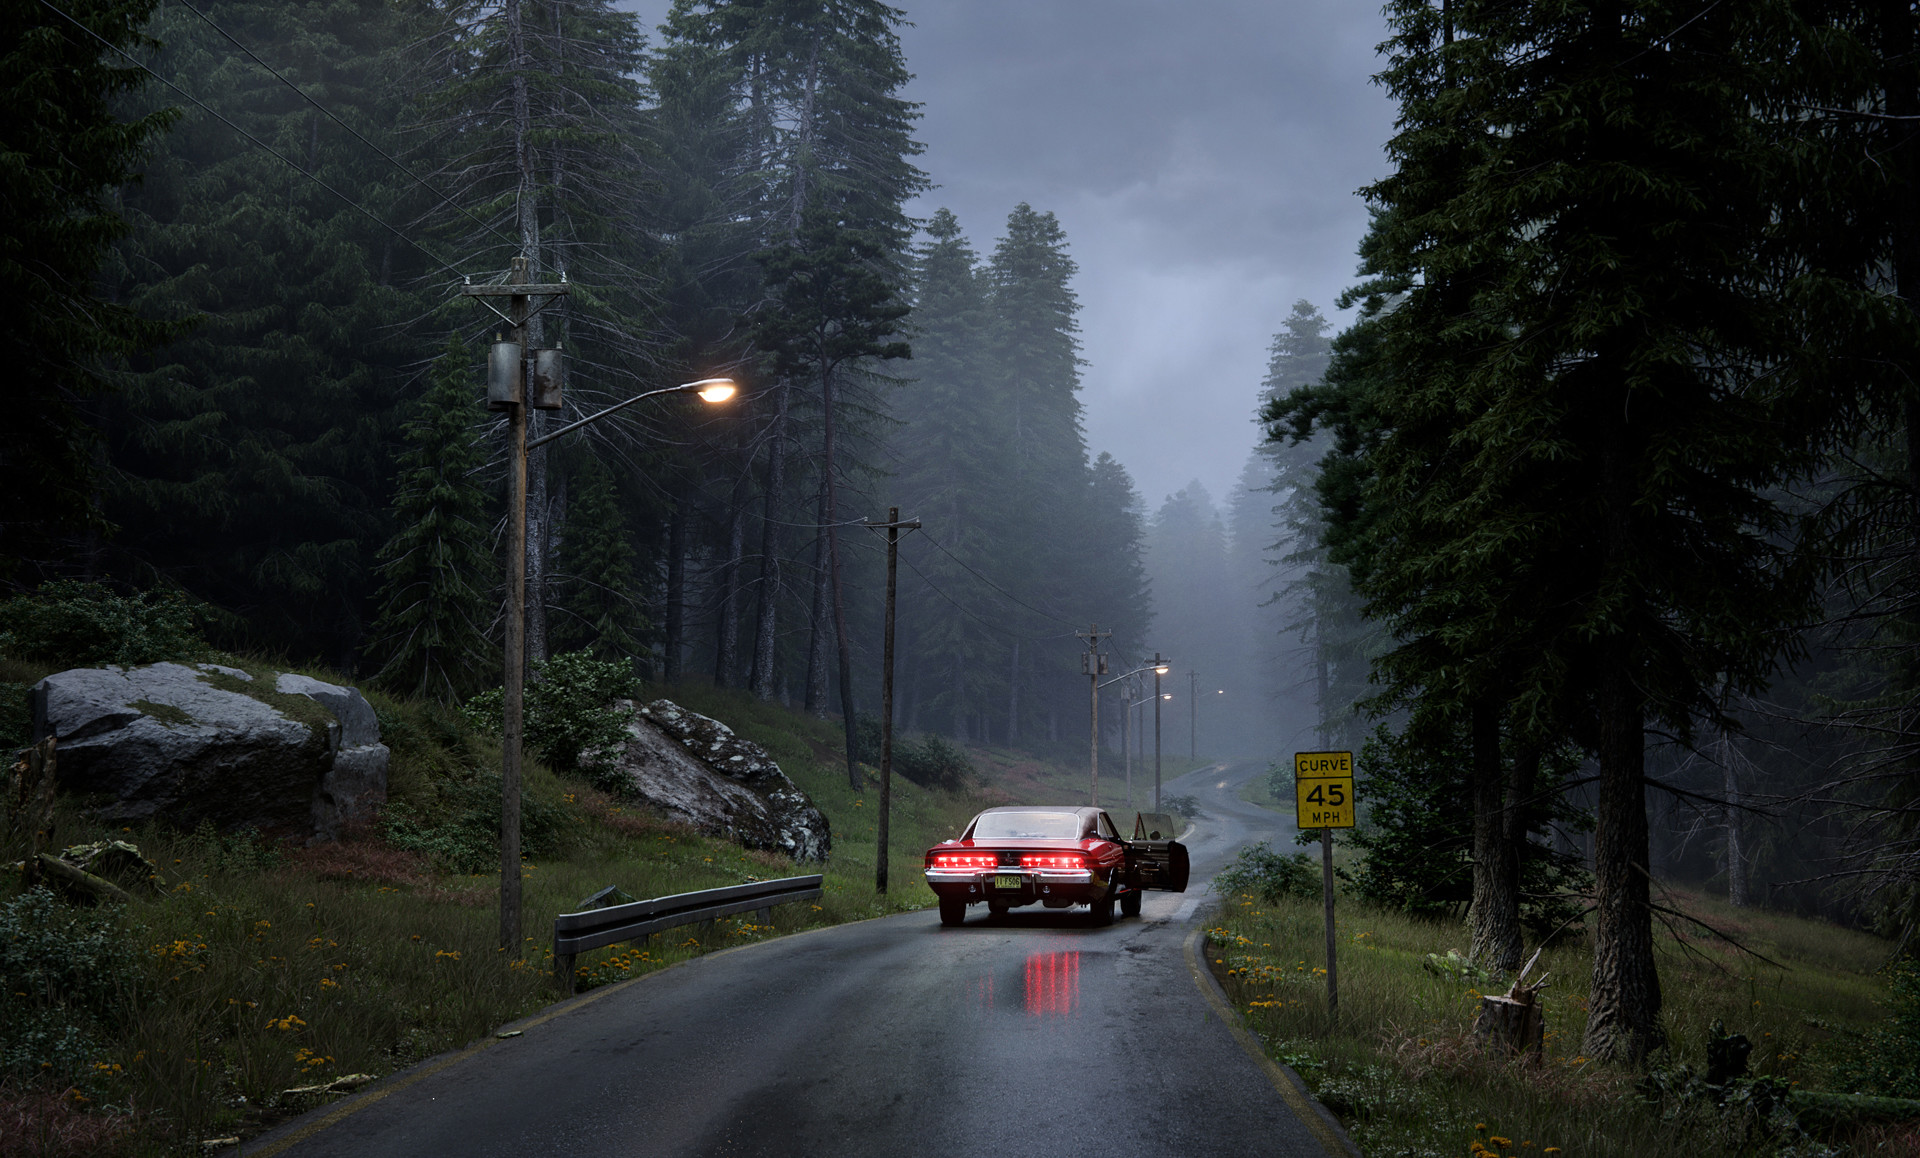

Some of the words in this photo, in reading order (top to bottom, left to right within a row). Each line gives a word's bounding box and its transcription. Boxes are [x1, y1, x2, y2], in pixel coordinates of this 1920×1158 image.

[1299, 759, 1349, 772] CURVE
[1306, 784, 1345, 806] 45
[1312, 811, 1340, 824] MPH
